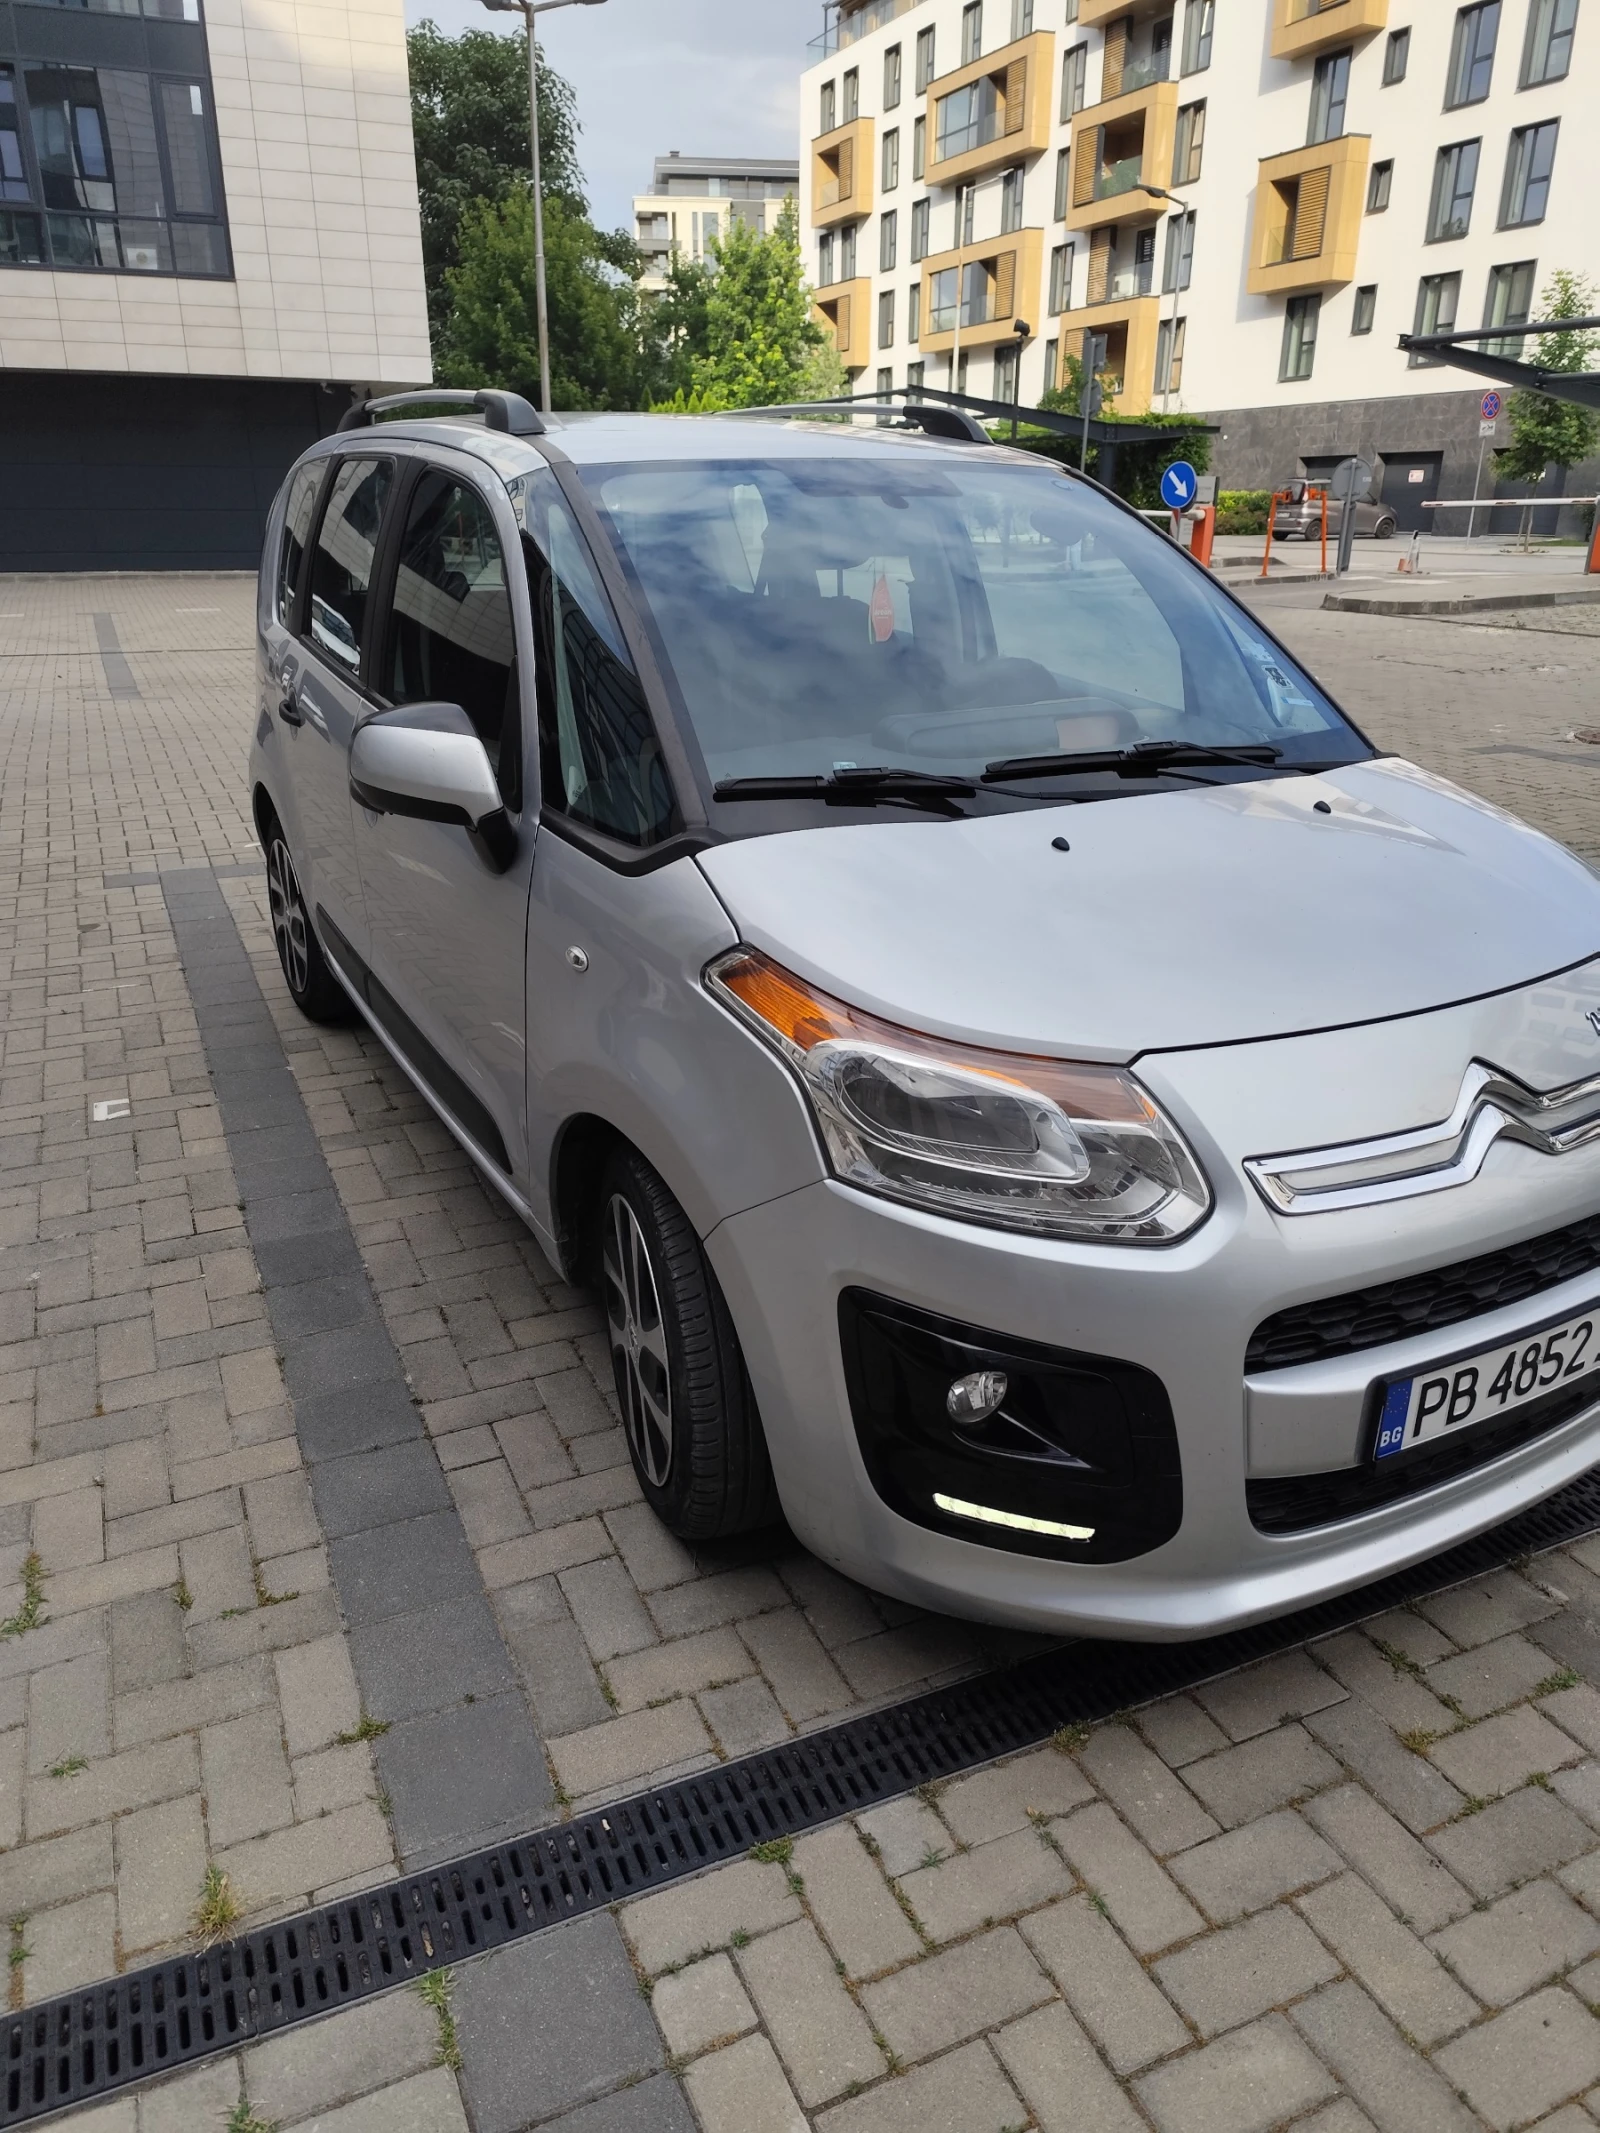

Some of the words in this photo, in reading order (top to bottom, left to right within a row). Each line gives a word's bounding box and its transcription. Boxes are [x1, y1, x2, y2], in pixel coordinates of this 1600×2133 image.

[1412, 1366, 1479, 1438] PB
[1487, 1320, 1593, 1405] 4852
[1380, 1427, 1402, 1447] BG
